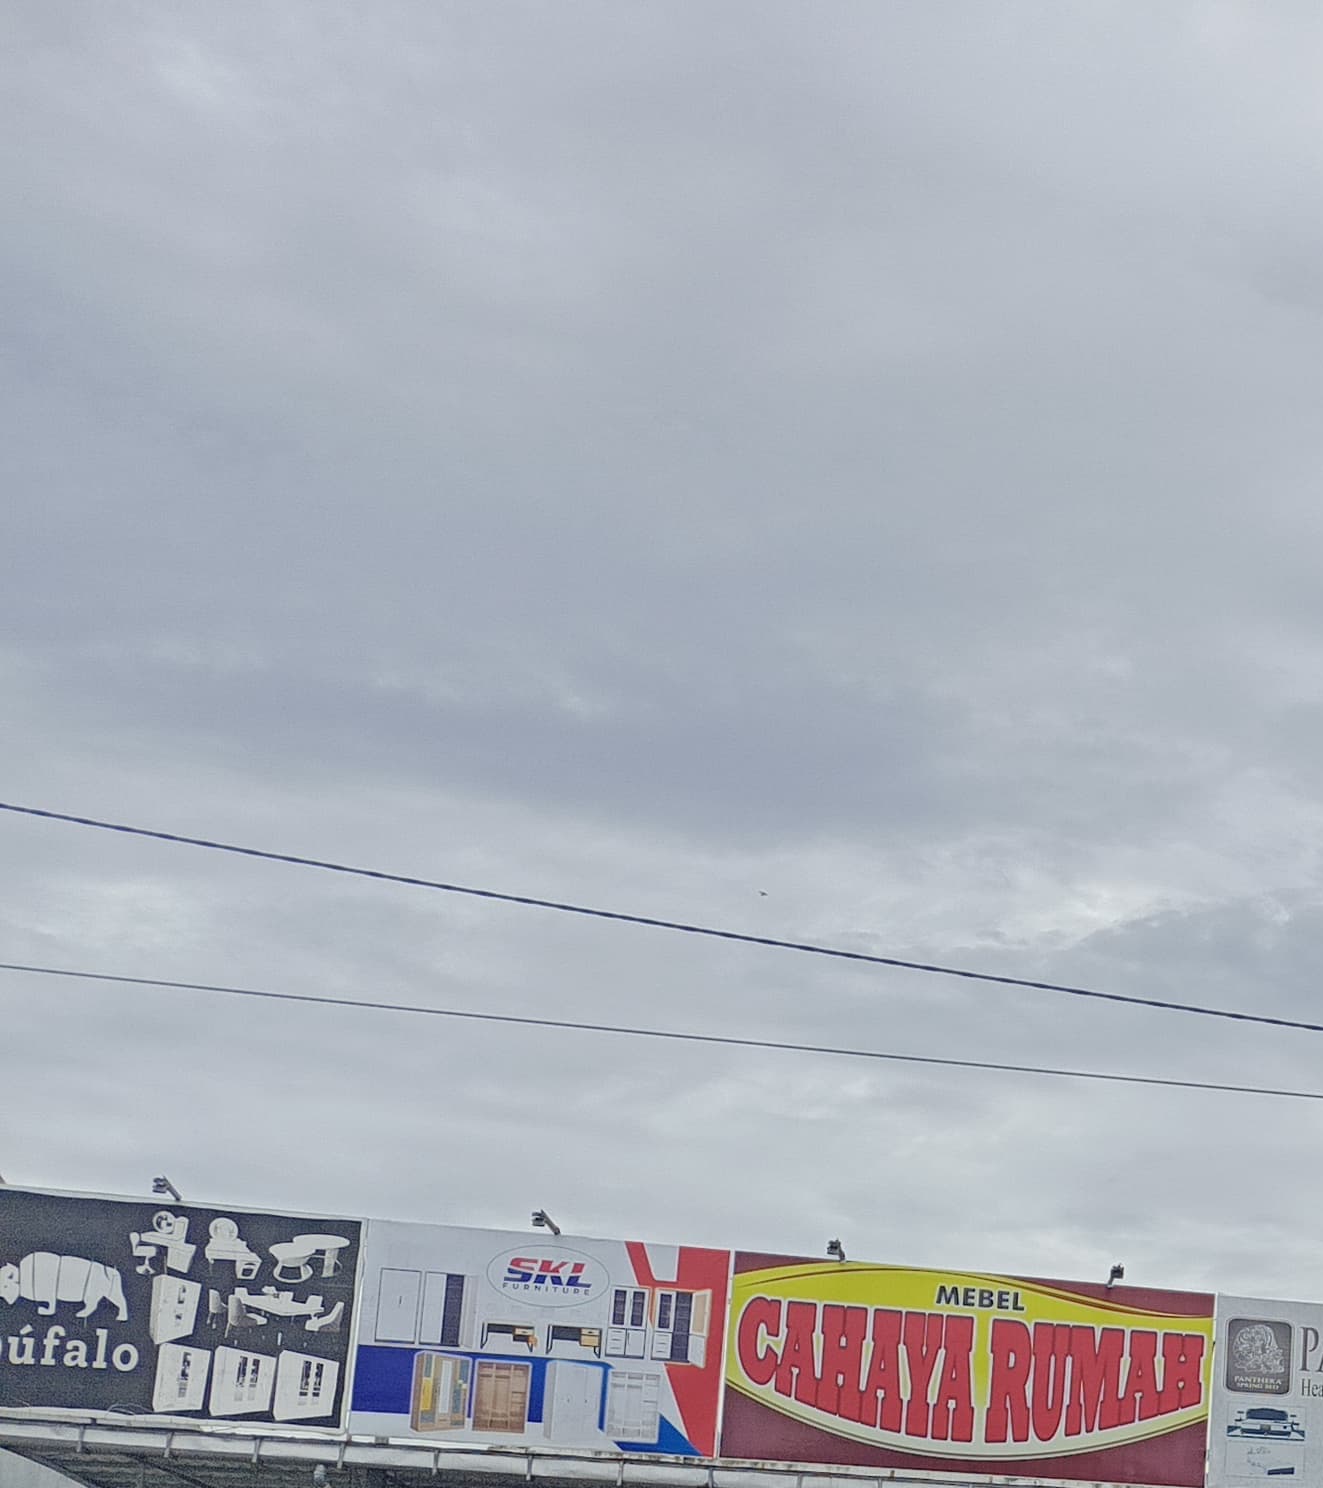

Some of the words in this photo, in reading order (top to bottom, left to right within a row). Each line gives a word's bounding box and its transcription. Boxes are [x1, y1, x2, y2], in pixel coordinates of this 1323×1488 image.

[503, 1257, 592, 1289] SKL
[502, 1282, 591, 1297] FURNITURE
[935, 1284, 1025, 1312] MEBEL
[0, 1324, 139, 1372] úfalo
[737, 1296, 975, 1442] CAHAYA
[984, 1318, 1206, 1443] RUMAH
